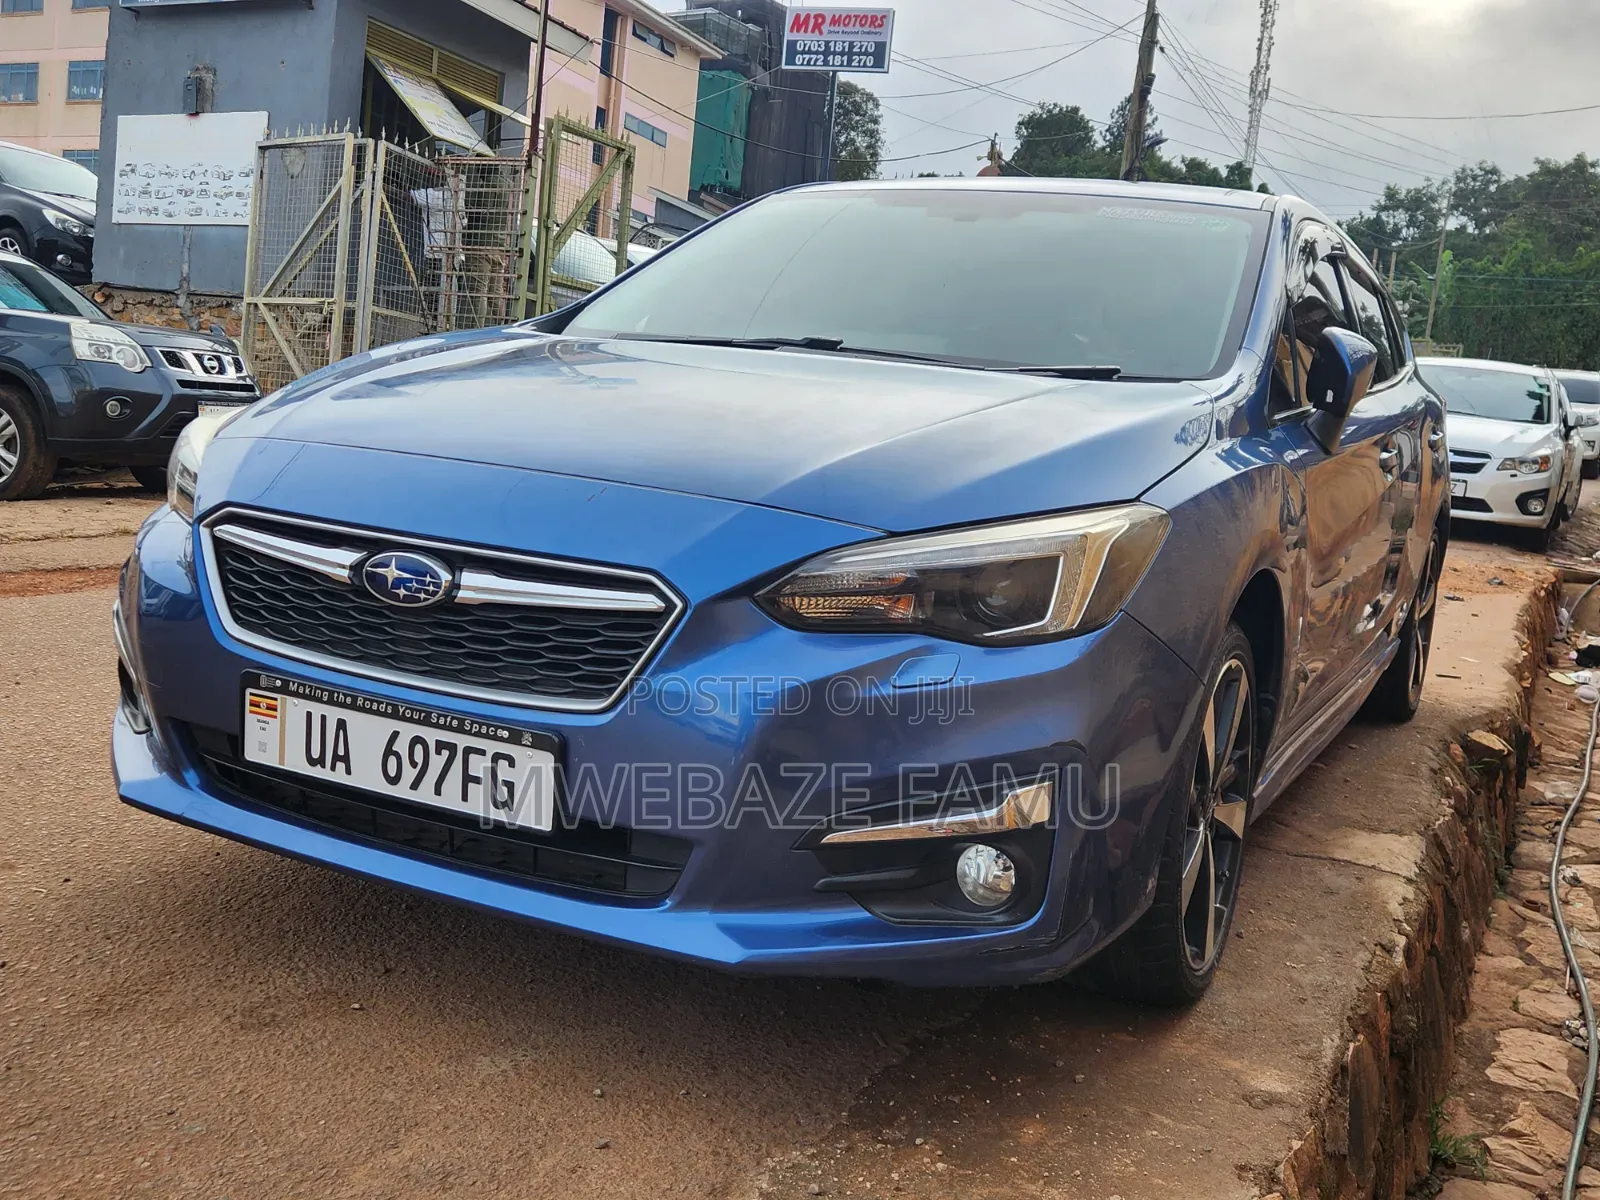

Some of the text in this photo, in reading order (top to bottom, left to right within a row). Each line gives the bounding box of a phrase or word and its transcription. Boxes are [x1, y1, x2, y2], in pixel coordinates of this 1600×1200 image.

[789, 12, 888, 36] MR MOTORS
[796, 40, 876, 53] 0703 181 270
[795, 54, 875, 67] 0772 181 270
[288, 681, 504, 738] Making the Roads Your Safe Space
[305, 710, 516, 812] UA 697FG
